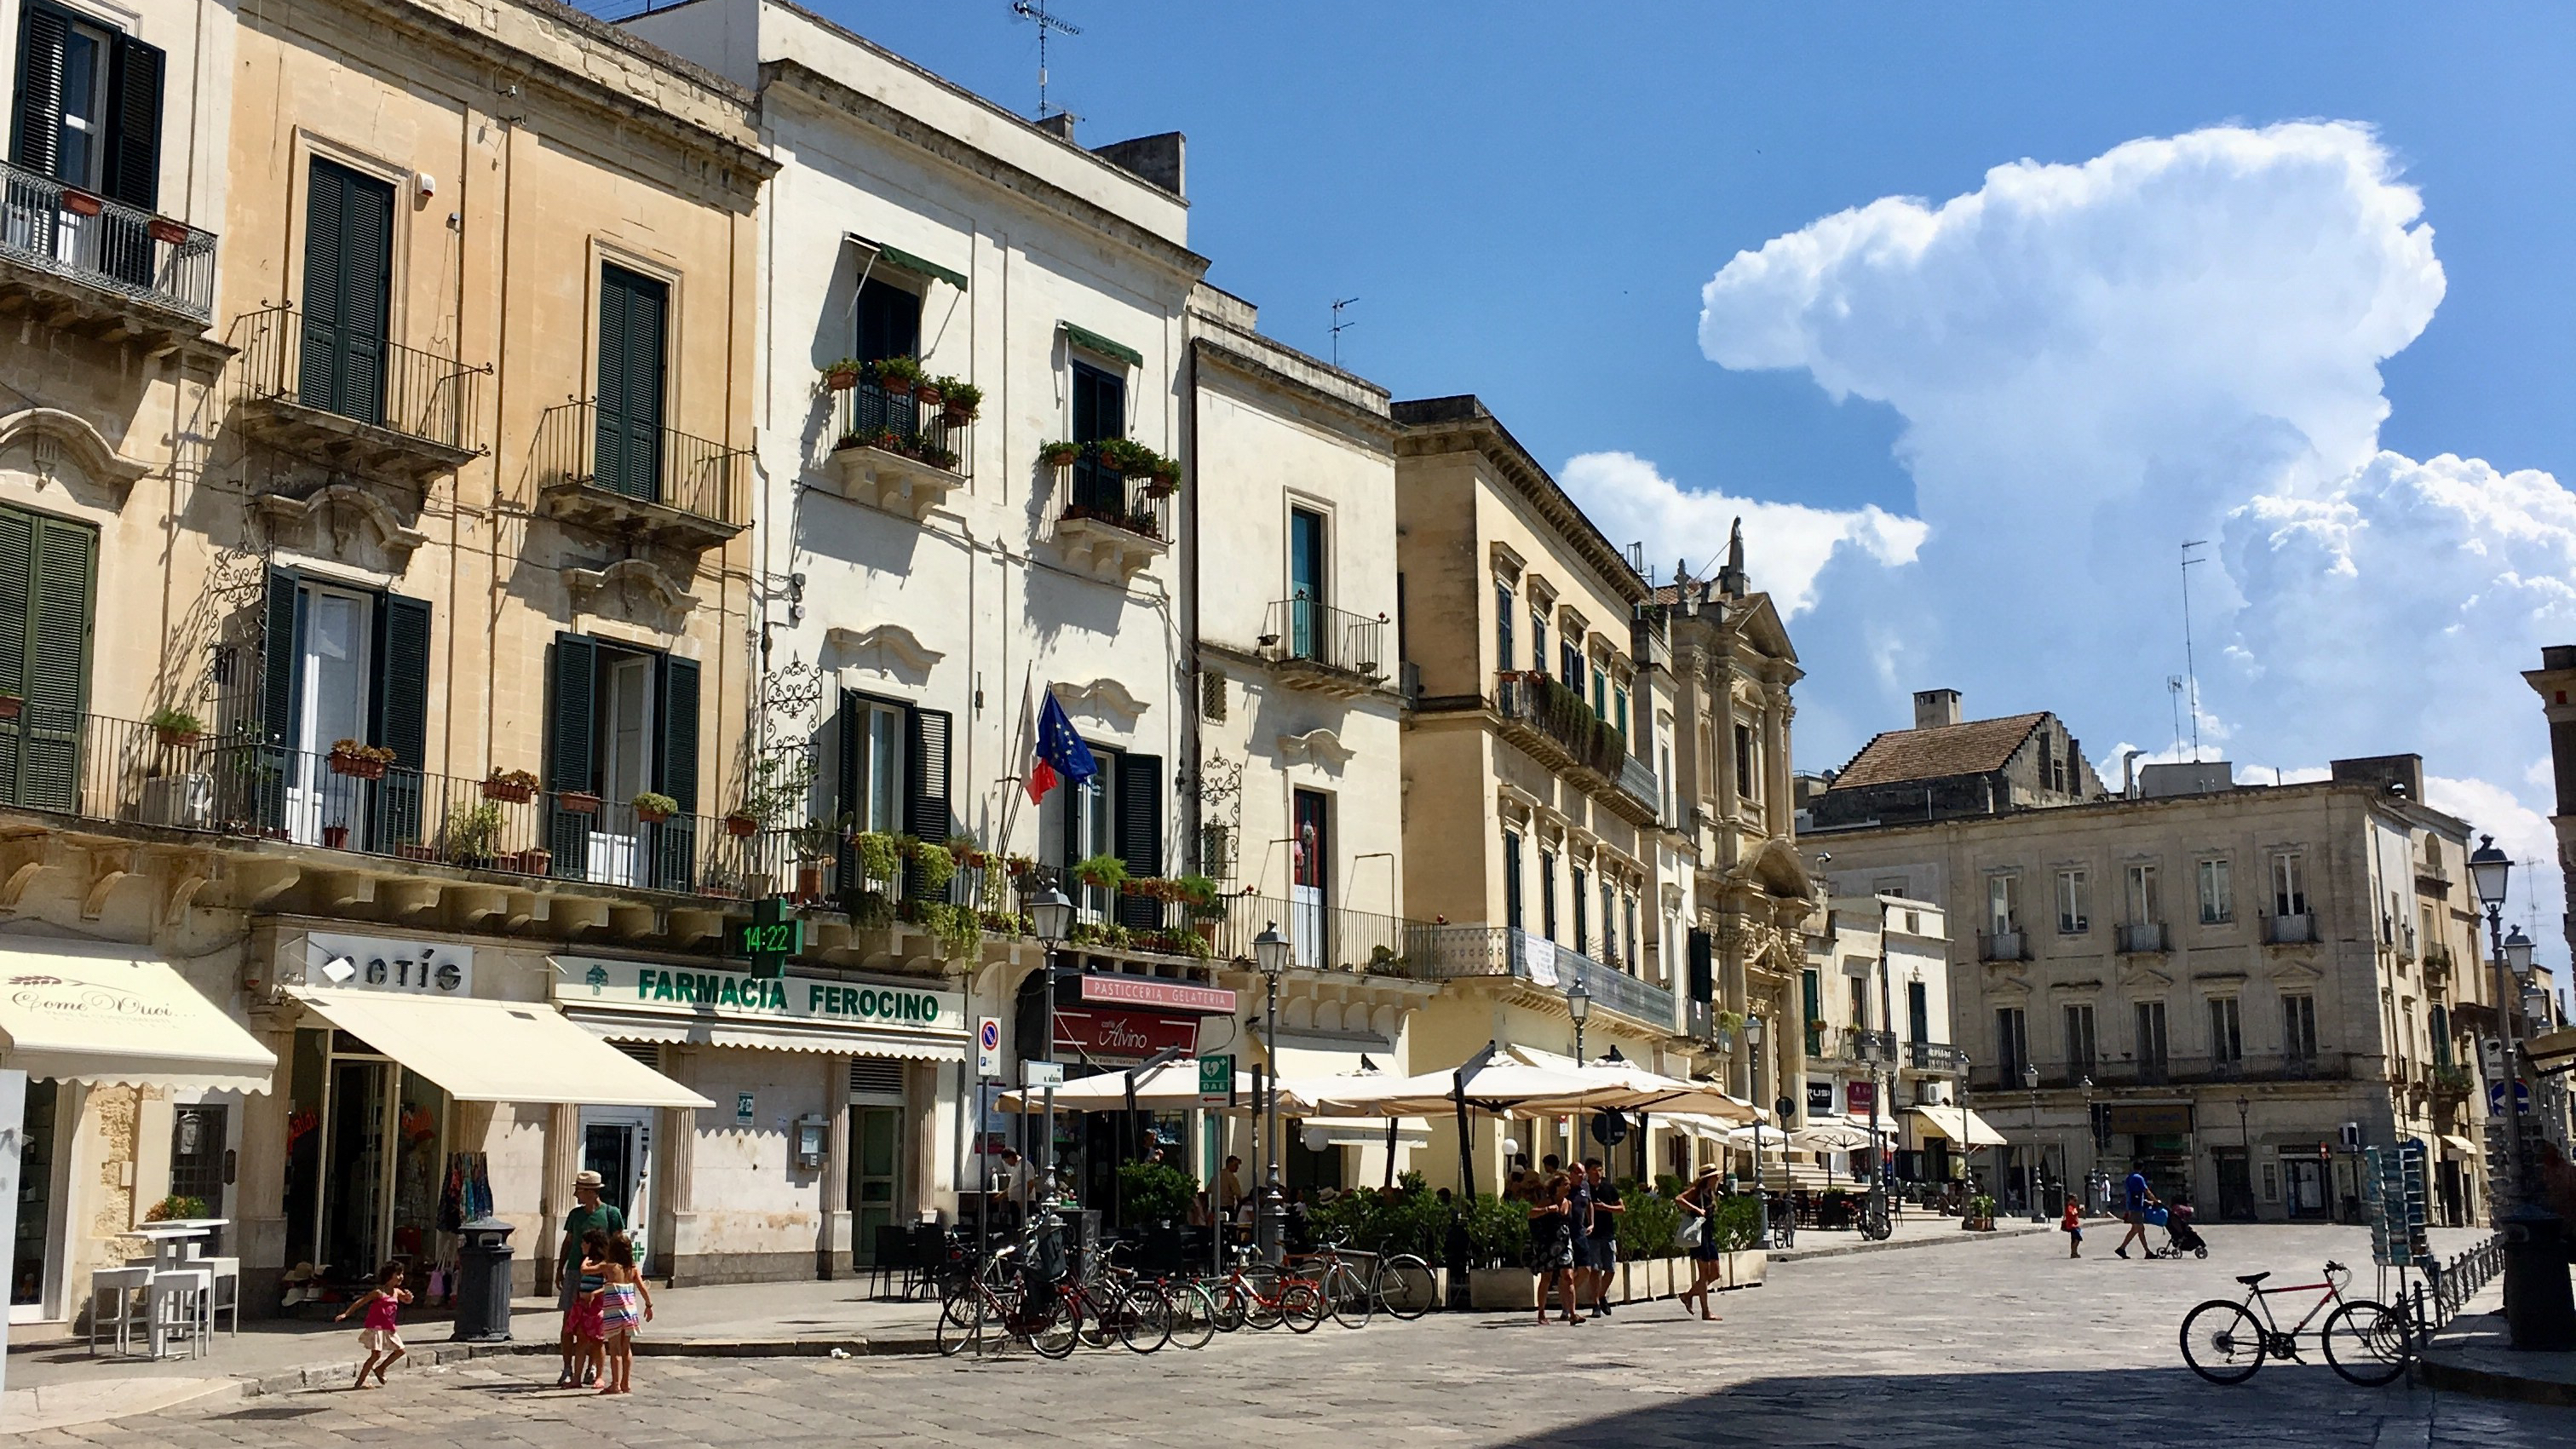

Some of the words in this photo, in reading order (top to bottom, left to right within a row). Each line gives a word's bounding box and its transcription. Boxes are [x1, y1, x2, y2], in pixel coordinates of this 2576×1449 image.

[744, 925, 788, 952] 14:22
[12, 991, 88, 1013] Come
[638, 969, 788, 1010] FARMACIA
[808, 985, 939, 1021] FEROCINO
[1095, 981, 1162, 998] PASTICCERIA
[1172, 989, 1226, 1005] GELATERIA
[1099, 1018, 1147, 1049] Alvino
[1203, 1082, 1225, 1090] DAE
